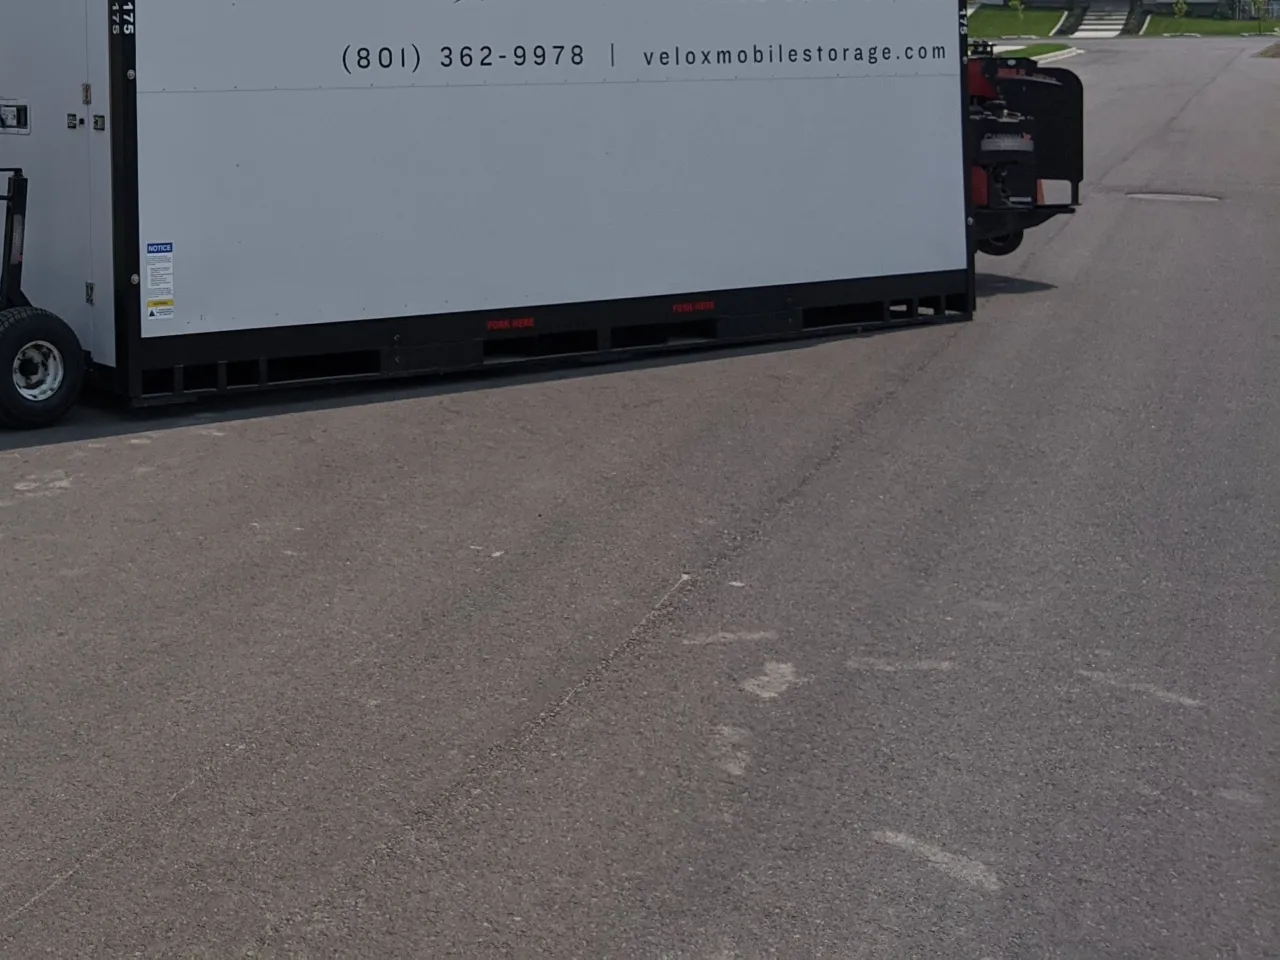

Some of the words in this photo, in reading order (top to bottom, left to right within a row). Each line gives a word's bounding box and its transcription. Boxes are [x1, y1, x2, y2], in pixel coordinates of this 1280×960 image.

[112, 2, 120, 34] 175
[123, 2, 134, 34] 175
[959, 9, 968, 35] 175
[340, 42, 422, 75] (801)
[439, 43, 586, 68] 362-9978
[643, 43, 947, 67] veloxmobilestorage.com
[148, 244, 171, 252] NOTICE
